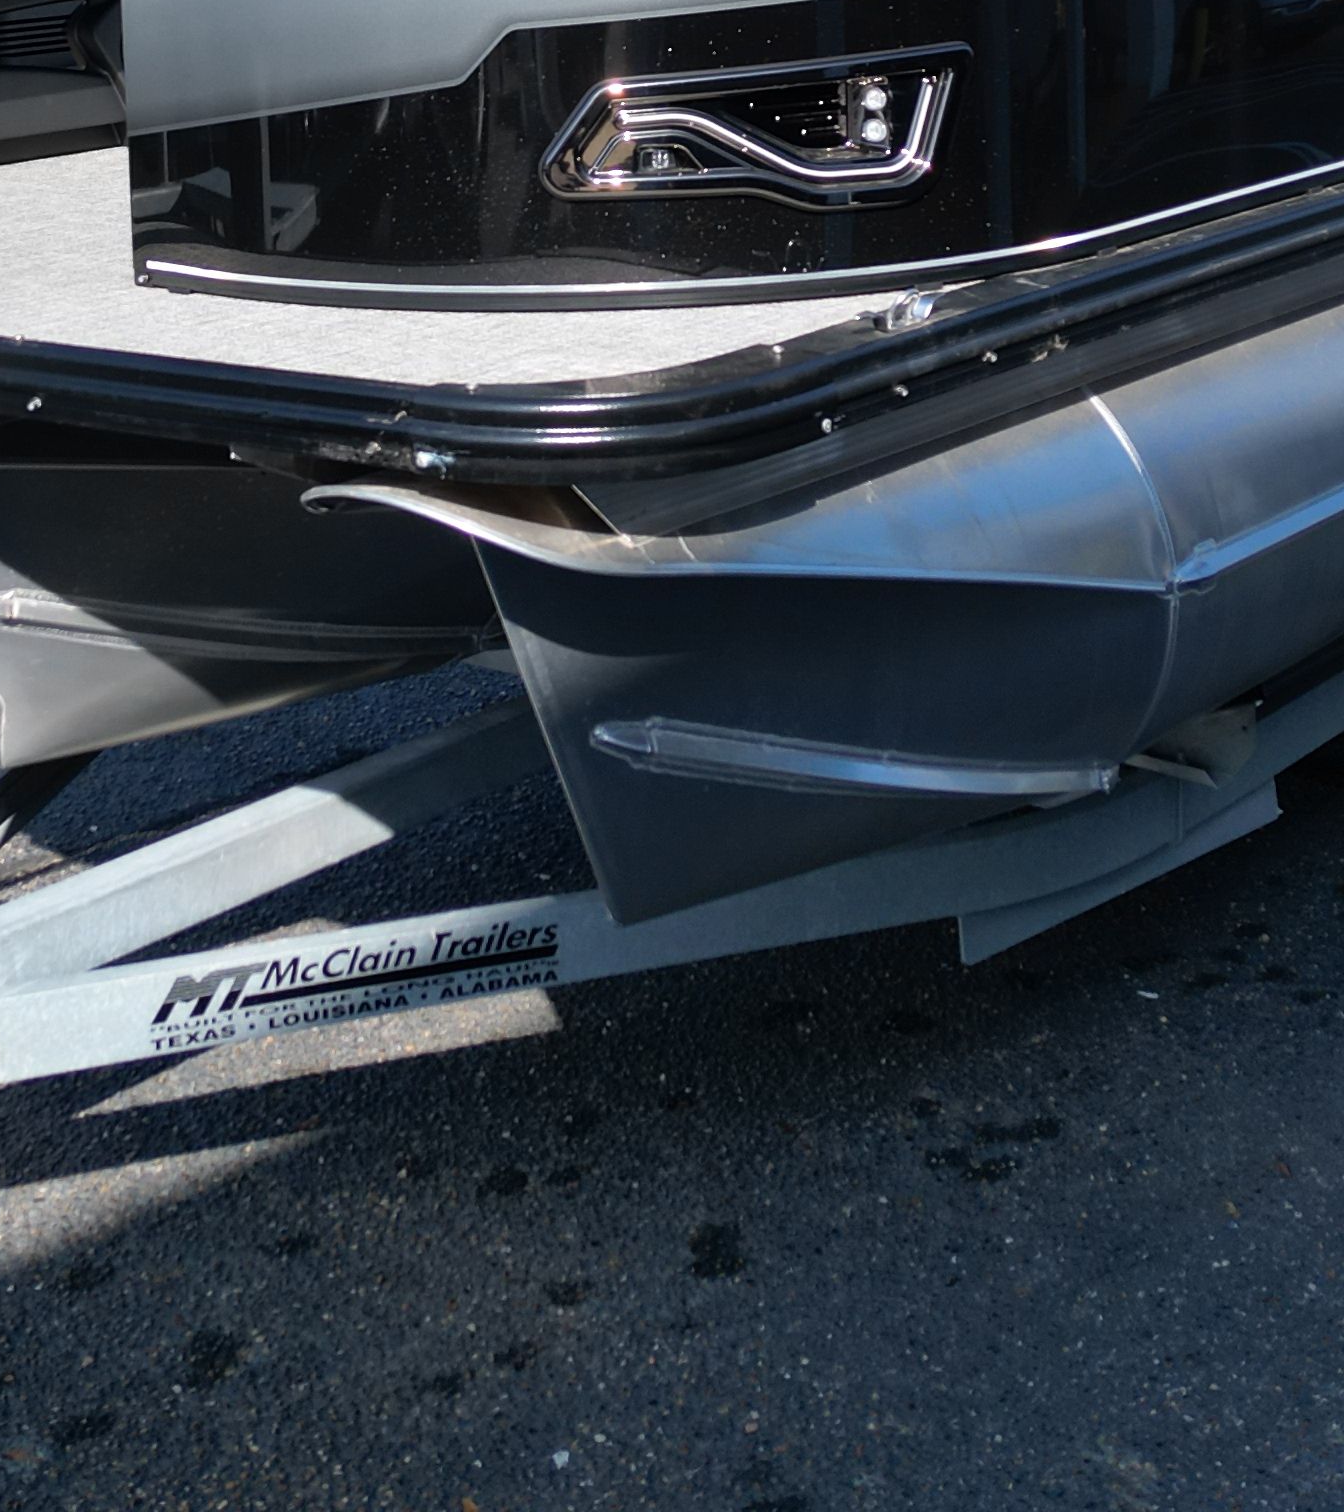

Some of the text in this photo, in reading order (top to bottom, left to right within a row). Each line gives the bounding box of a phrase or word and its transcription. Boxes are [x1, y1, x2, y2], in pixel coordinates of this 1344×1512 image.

[260, 920, 558, 990] McClain Trailers
[151, 969, 558, 1051] TEXAS LOUISIANA ALABAMA
